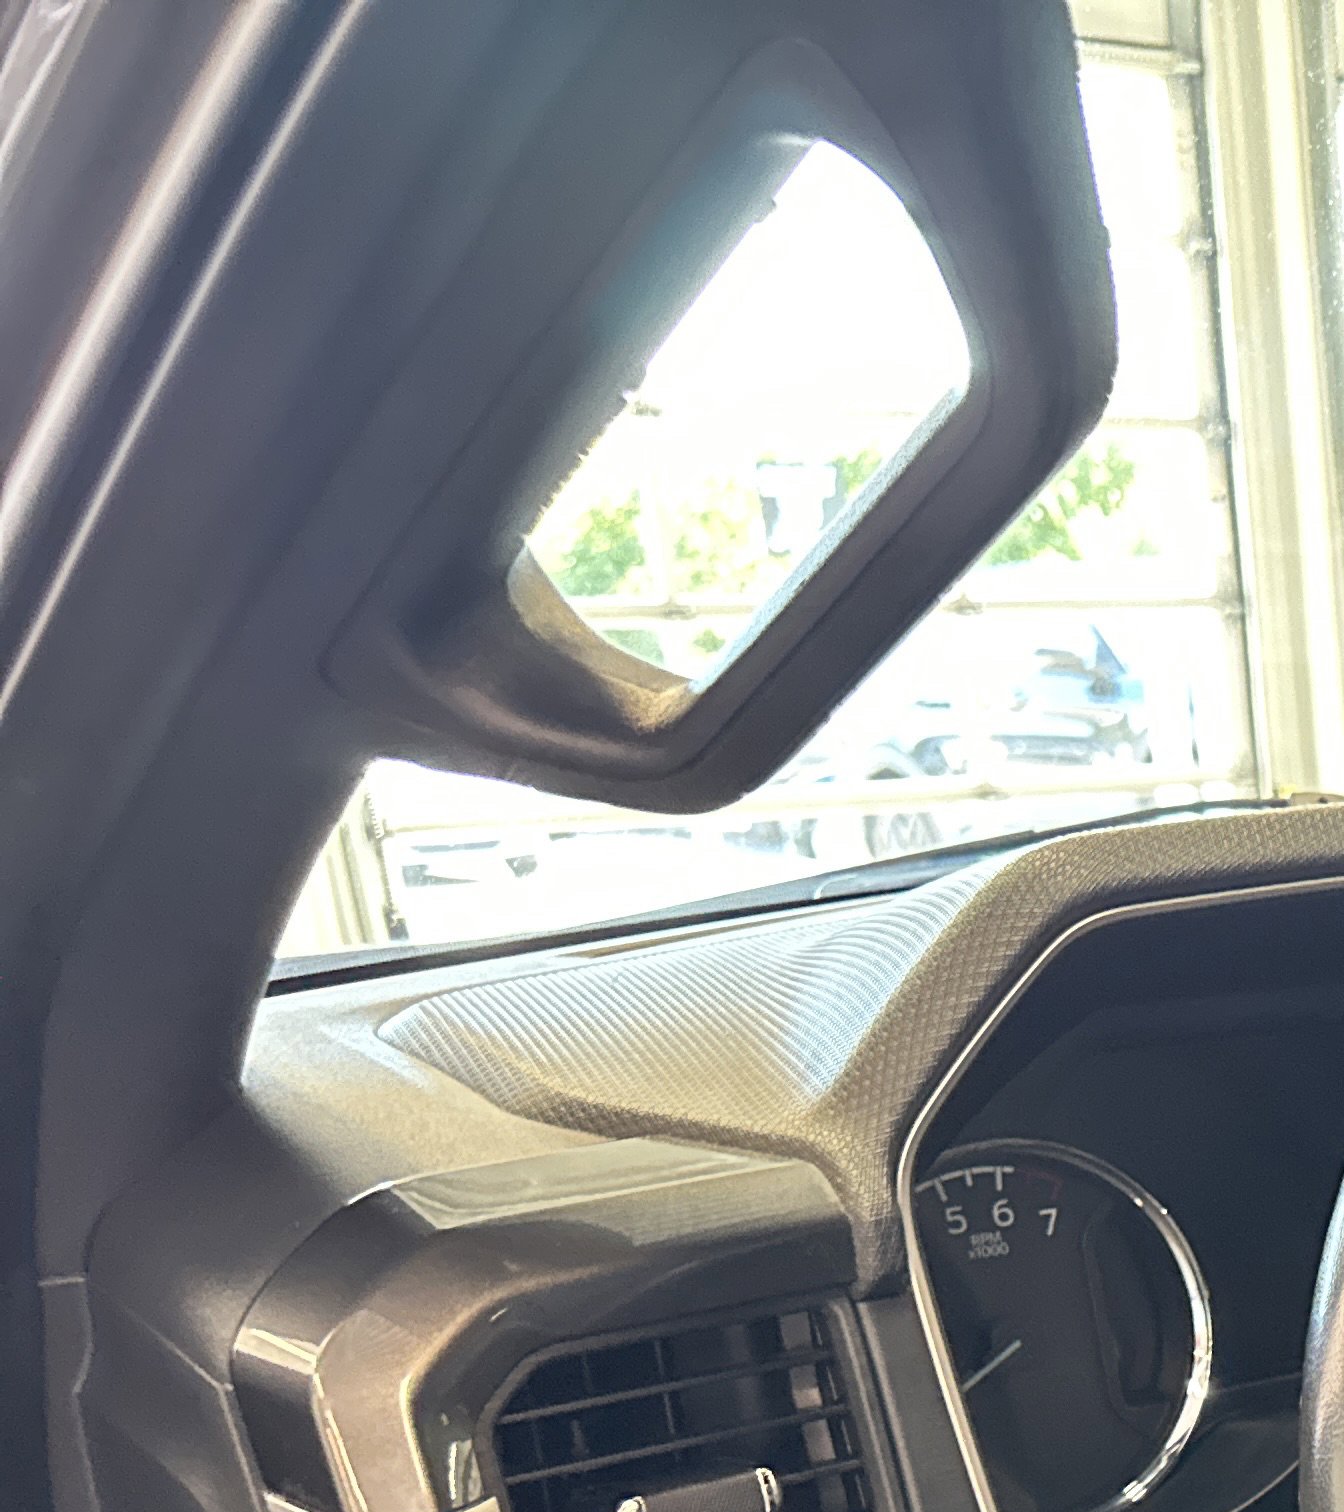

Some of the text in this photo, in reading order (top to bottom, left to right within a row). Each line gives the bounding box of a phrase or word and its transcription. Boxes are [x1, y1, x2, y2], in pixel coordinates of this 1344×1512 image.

[944, 1205, 968, 1235] 5
[992, 1198, 1015, 1227] 6
[1038, 1207, 1058, 1236] 7
[970, 1231, 1003, 1247] RPM
